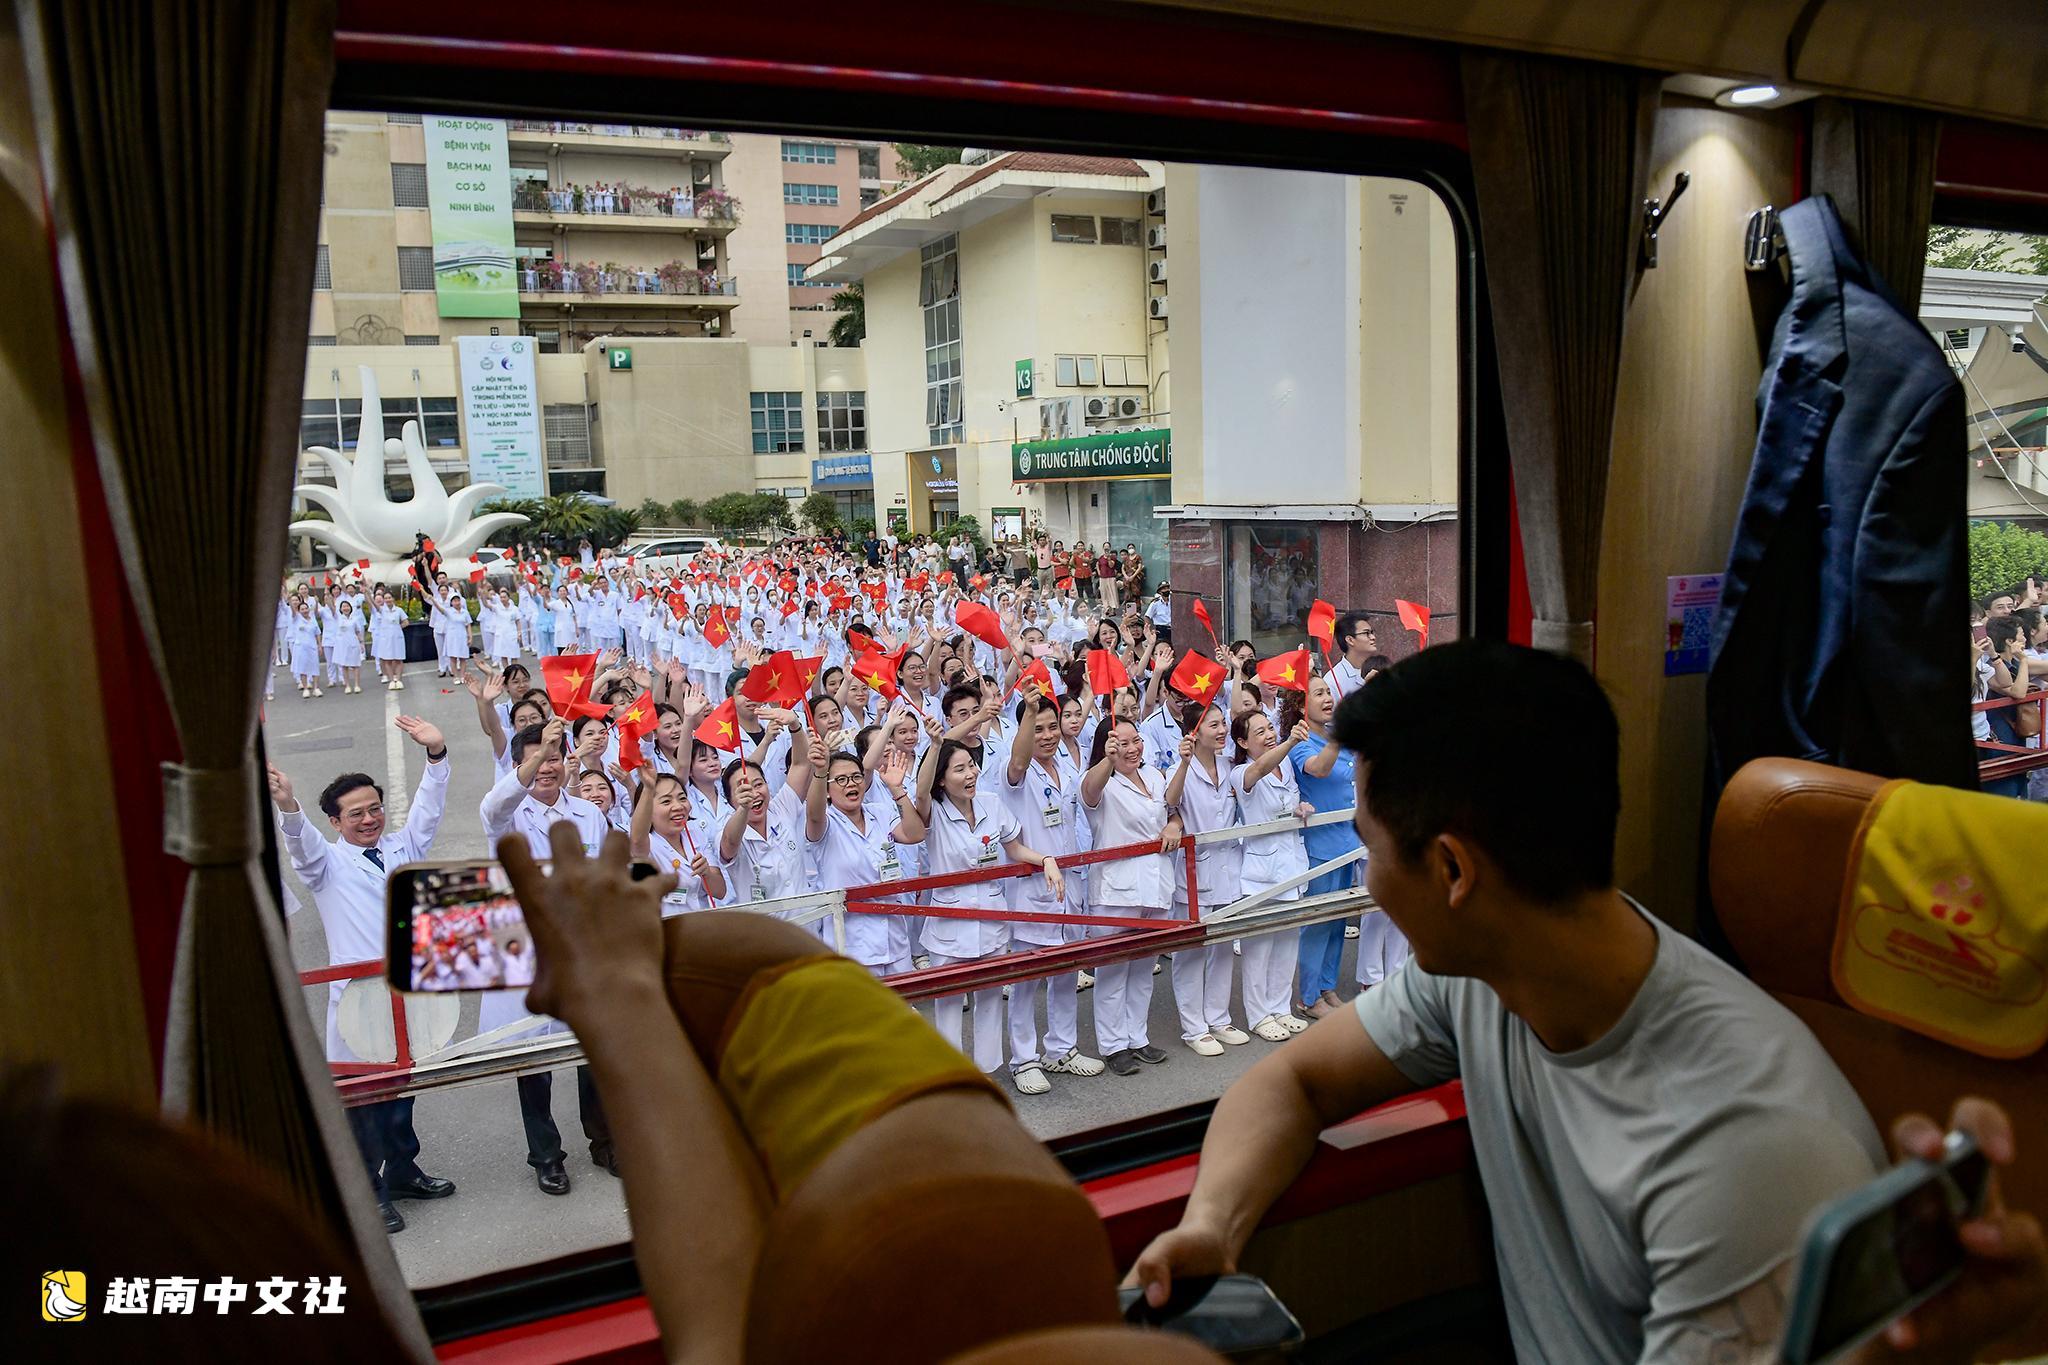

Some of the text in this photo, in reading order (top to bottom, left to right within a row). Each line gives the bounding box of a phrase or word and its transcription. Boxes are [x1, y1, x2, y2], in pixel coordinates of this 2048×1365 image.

[437, 119, 494, 132] HOẠT ĐỘNG
[444, 140, 491, 152] BỆNH VIỆN
[447, 161, 491, 173] BẠCH MAI
[455, 180, 486, 192] CƠ SỞ
[449, 202, 495, 213] NINH BÌNH
[614, 351, 627, 367] P
[1017, 370, 1031, 390] K3
[1035, 452, 1067, 470] TRUNG
[1068, 447, 1090, 467] TÂM
[1091, 442, 1131, 466] CHỐNG
[1133, 441, 1160, 468] ĐỘC
